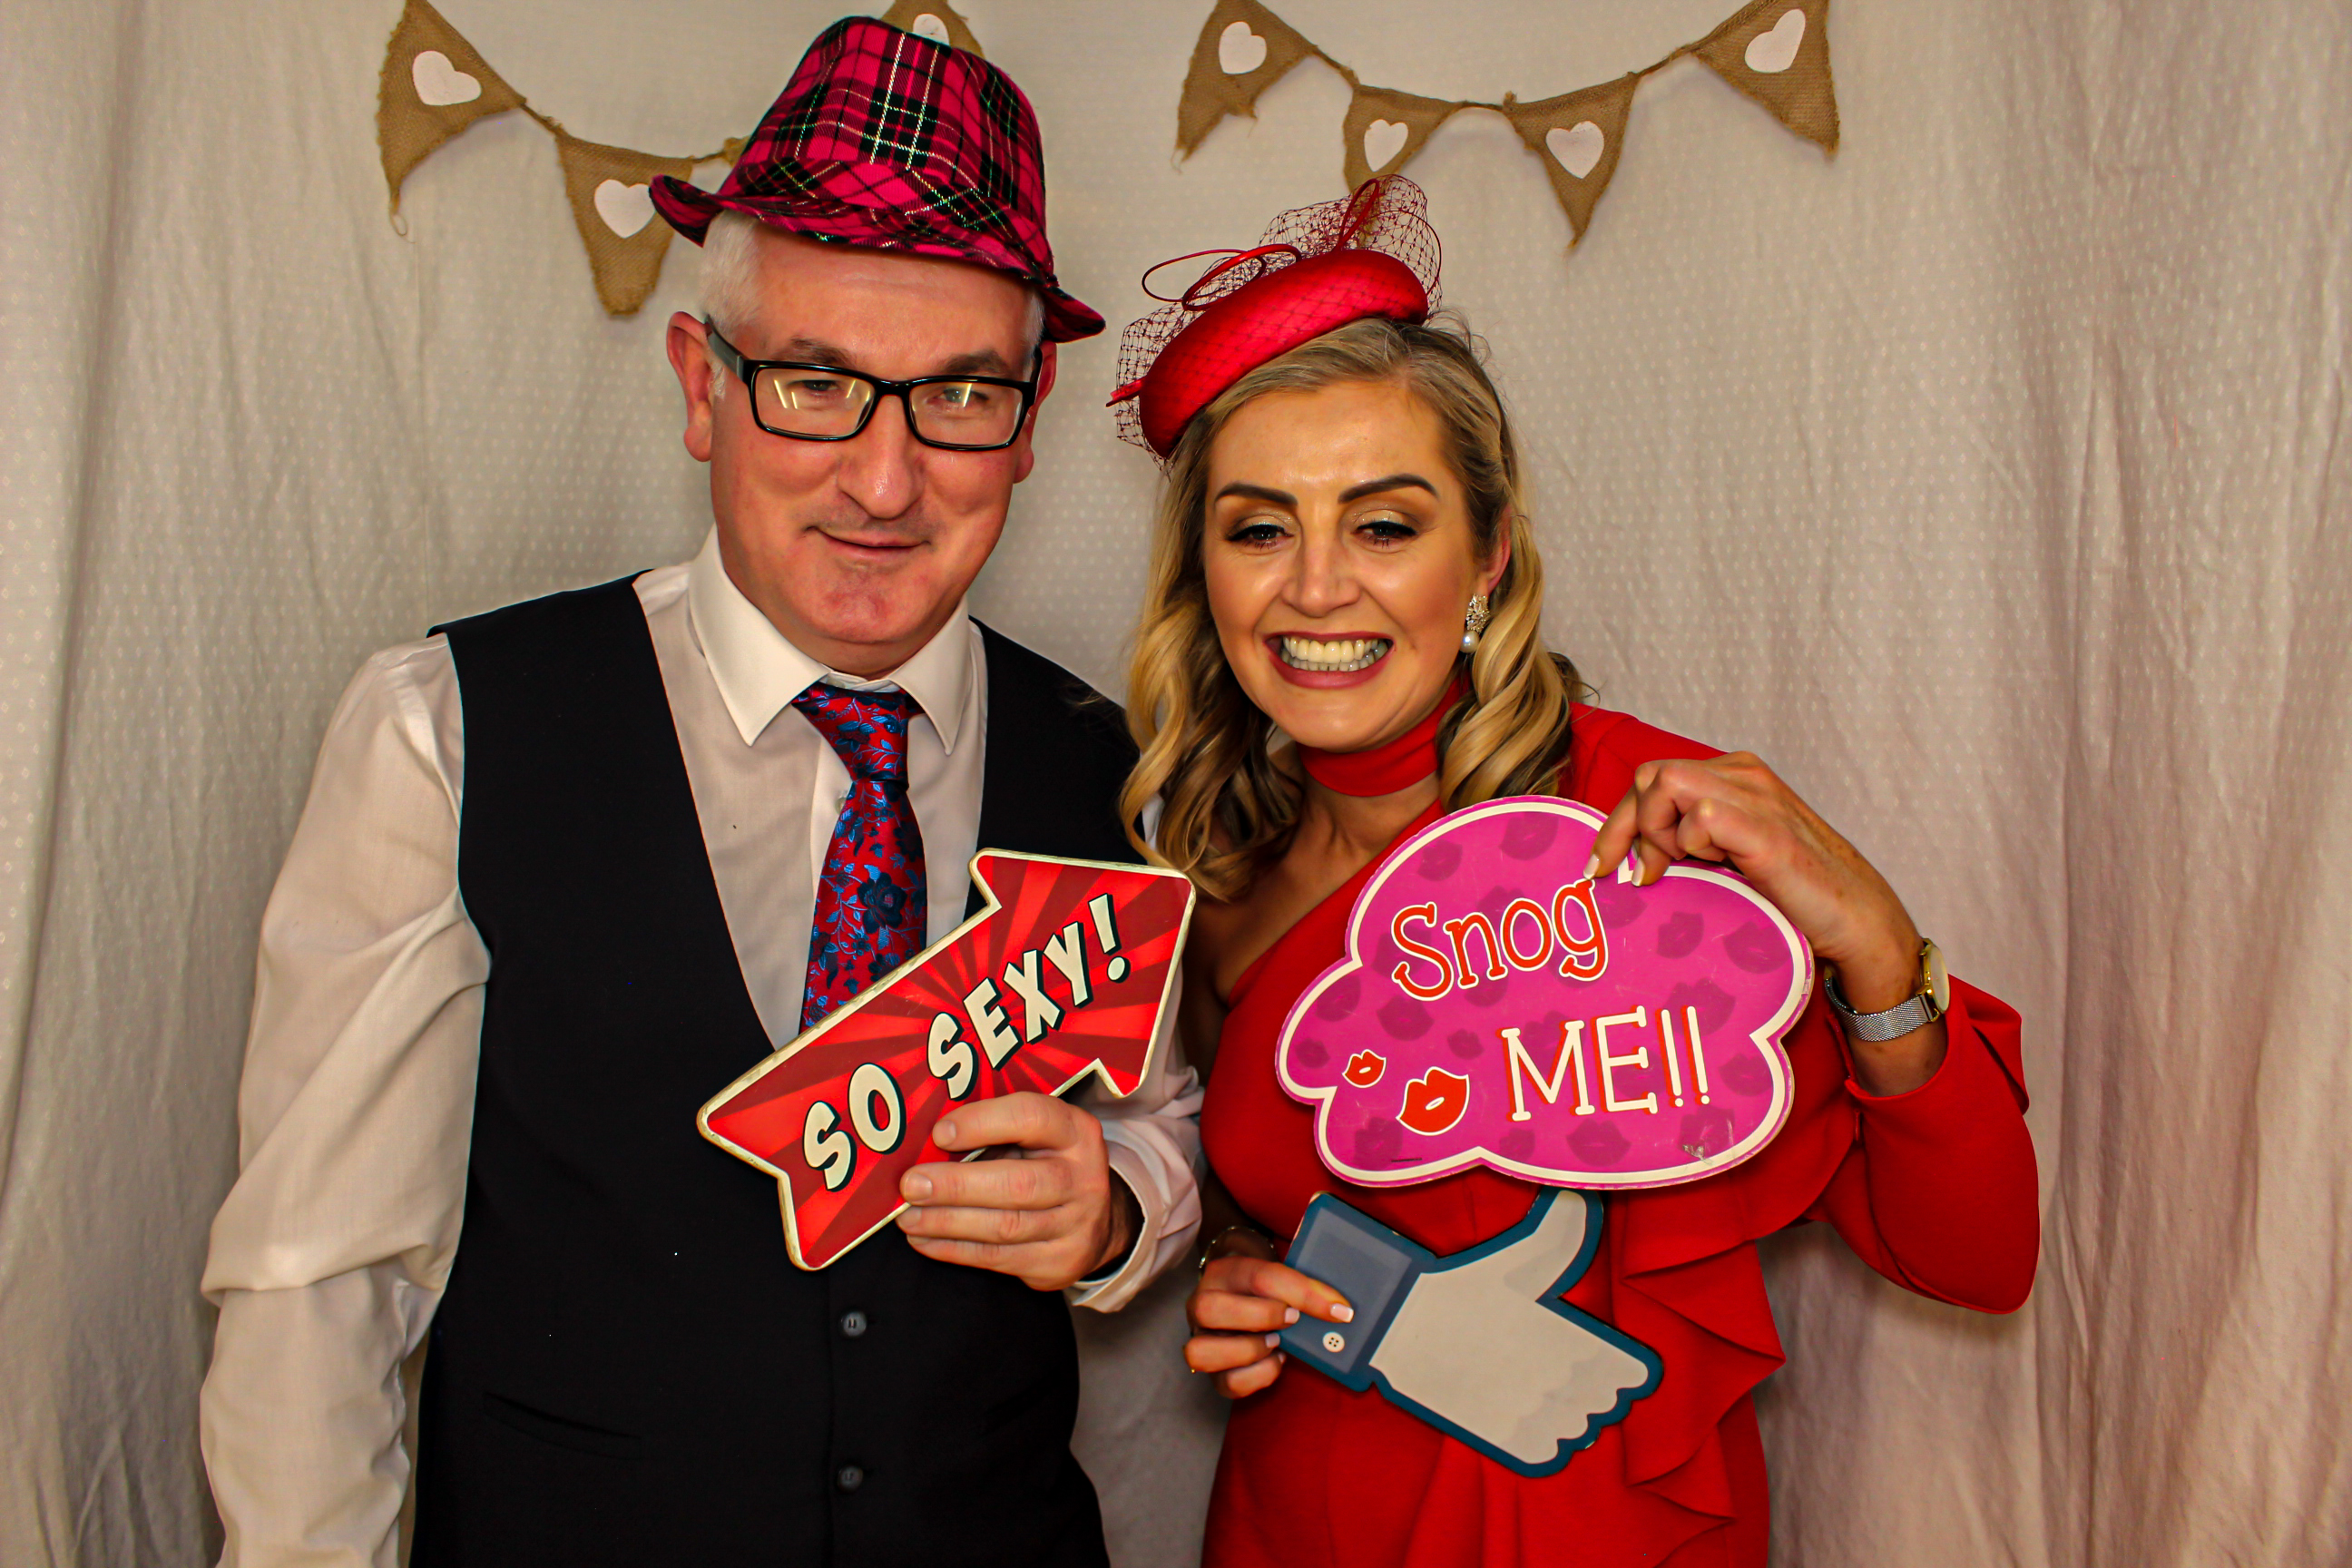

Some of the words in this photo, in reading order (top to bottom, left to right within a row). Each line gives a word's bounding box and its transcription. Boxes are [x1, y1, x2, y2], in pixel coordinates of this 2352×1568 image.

[1391, 877, 1609, 1001] Snog
[803, 1063, 905, 1191] SO
[927, 894, 1131, 1100] SEXY!
[1498, 1005, 1710, 1122] ME!!
